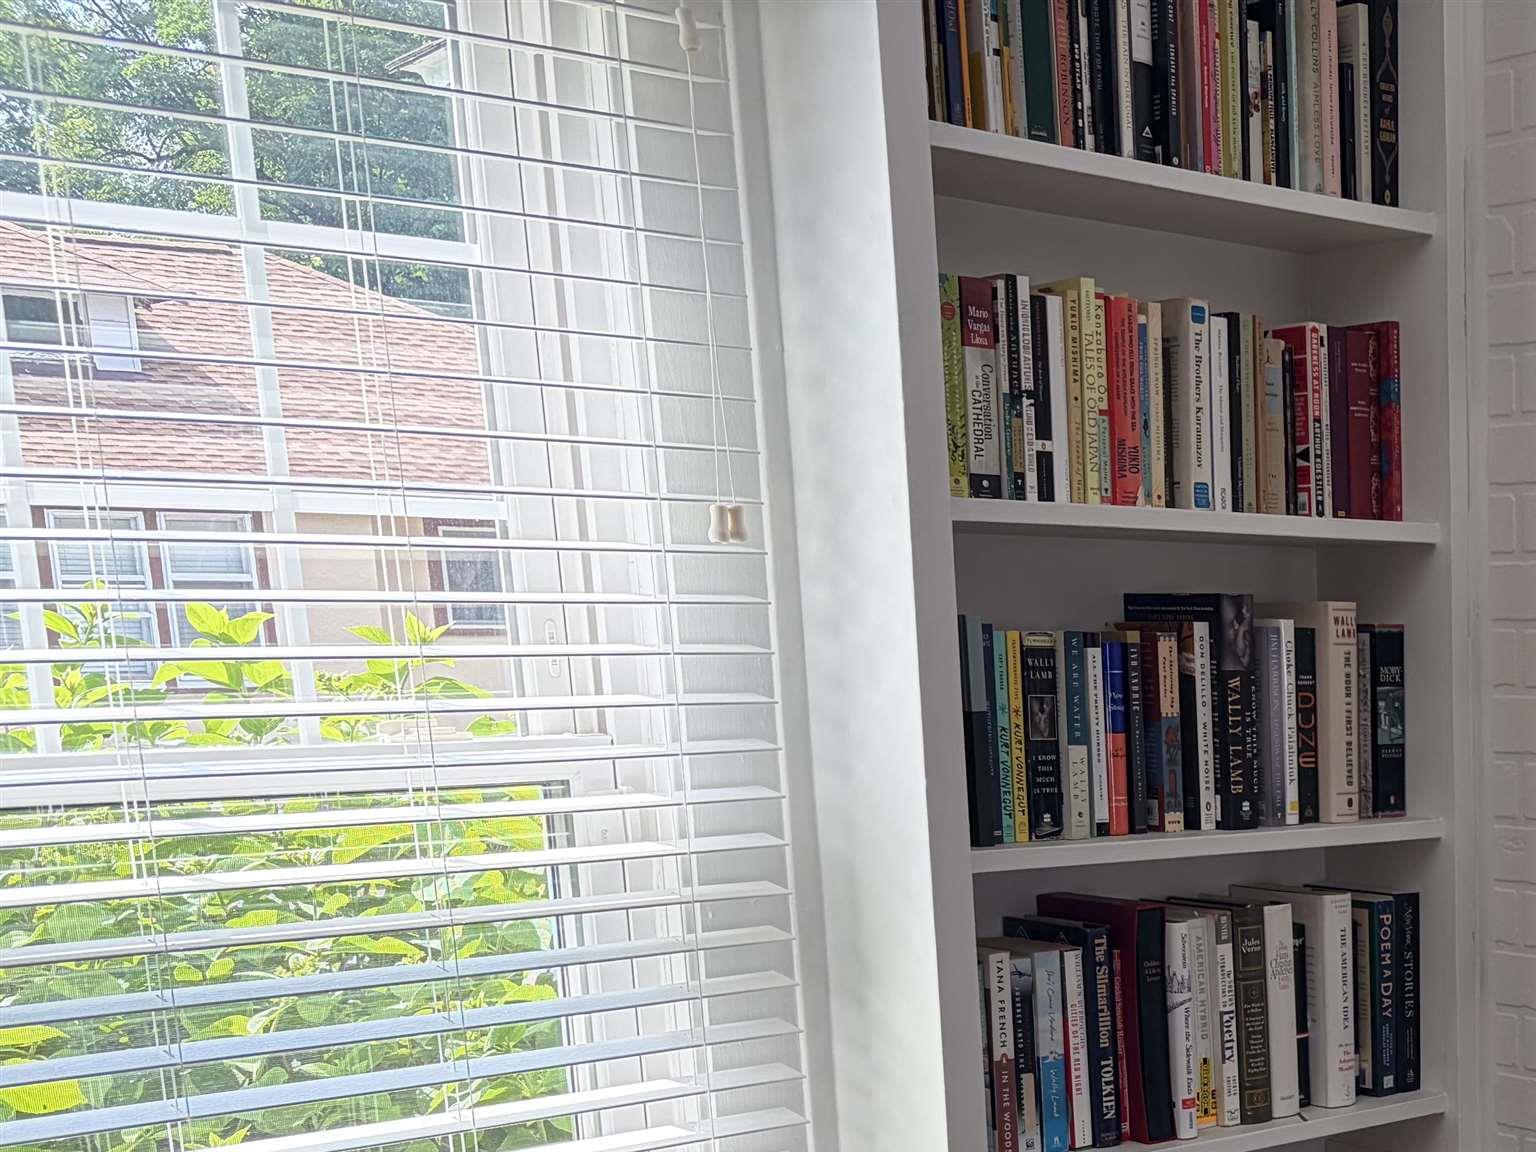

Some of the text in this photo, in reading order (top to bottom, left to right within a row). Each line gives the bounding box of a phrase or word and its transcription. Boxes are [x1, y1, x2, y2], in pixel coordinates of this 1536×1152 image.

[1060, 54, 1071, 126] ROBINSON
[1310, 24, 1321, 164] COLLINS AIMLESS LOVE
[967, 306, 989, 319] Mario
[967, 319, 990, 333] Vargas
[970, 332, 989, 346] Llosa
[971, 389, 985, 461] CATHEDRAL
[980, 364, 995, 441] Conversation
[1194, 330, 1205, 470] The Brothers Karamazov
[1127, 444, 1140, 475] YUKIO
[1227, 676, 1243, 795] WALLY LAMB
[1298, 691, 1316, 768] DUNE
[1000, 726, 1012, 820] KURT VONNEGUT
[1014, 722, 1026, 817] KURT VONNEGUT
[995, 959, 1009, 1048] TANA FRENCH
[1094, 934, 1112, 1048] The Silmarillion
[1379, 913, 1393, 1018] POEM A DAY
[1403, 951, 1416, 1019] STORIES
[1101, 1056, 1116, 1120] TOLKIEN
